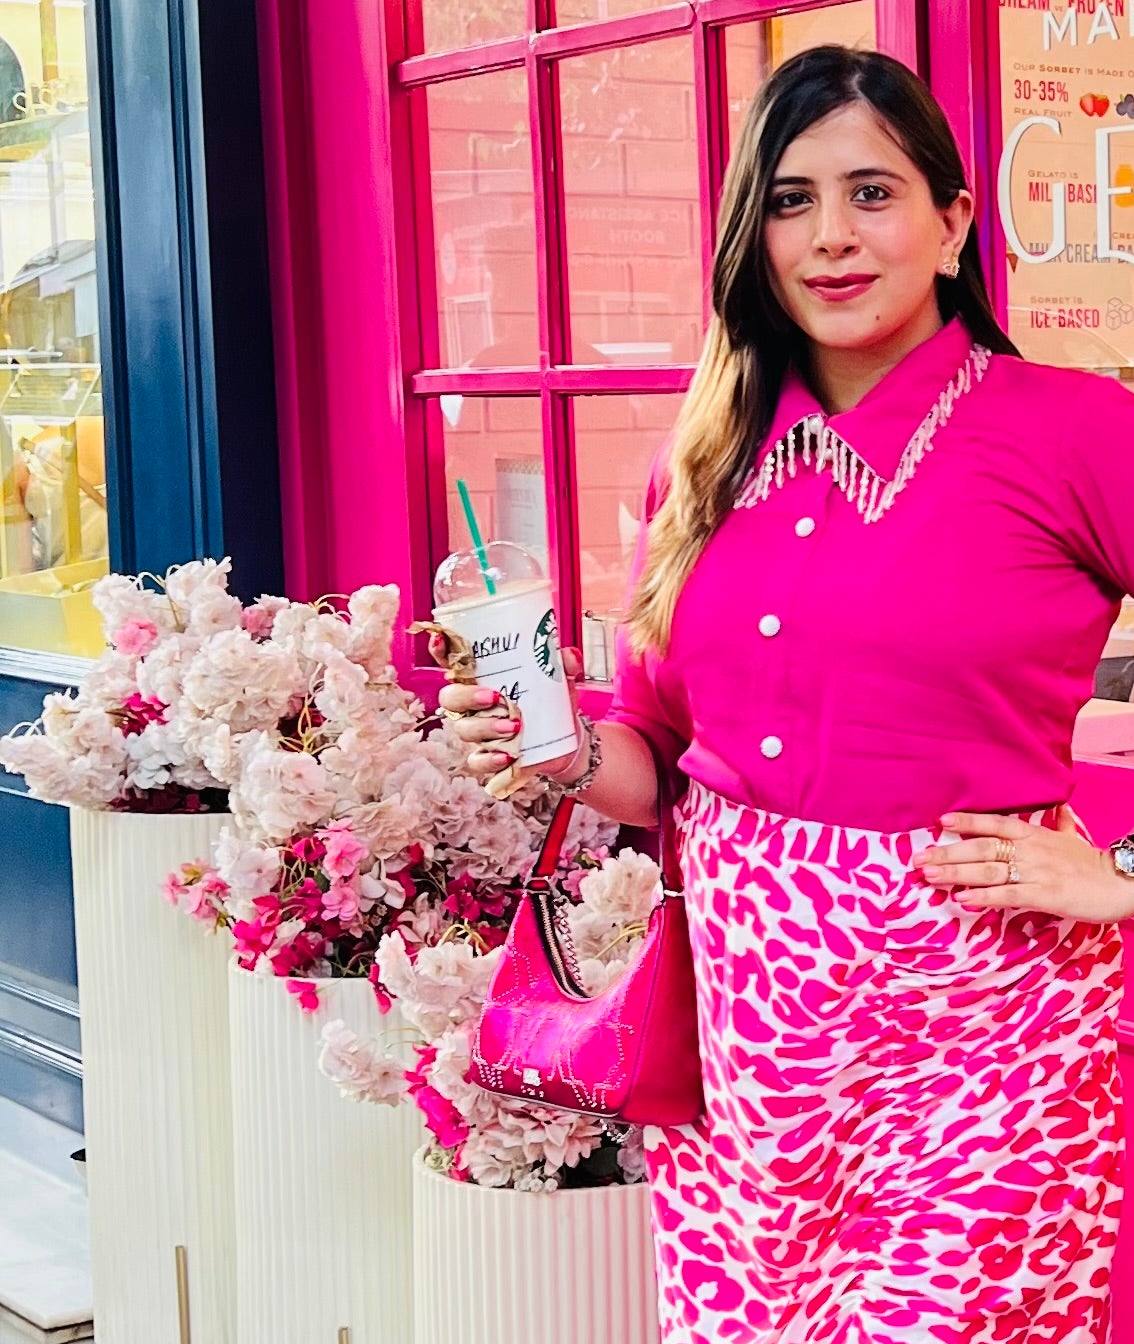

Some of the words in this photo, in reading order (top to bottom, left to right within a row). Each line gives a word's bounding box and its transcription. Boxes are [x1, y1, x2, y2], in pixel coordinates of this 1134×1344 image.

[1040, 64, 1081, 74] SORBET
[1014, 79, 1069, 102] 30-35%
[1014, 107, 1040, 116] REAL
[1044, 109, 1072, 117] FRUIT
[1028, 169, 1066, 178] GELATO
[1066, 243, 1111, 263] CREA
[1030, 308, 1100, 328] ICE-BASED
